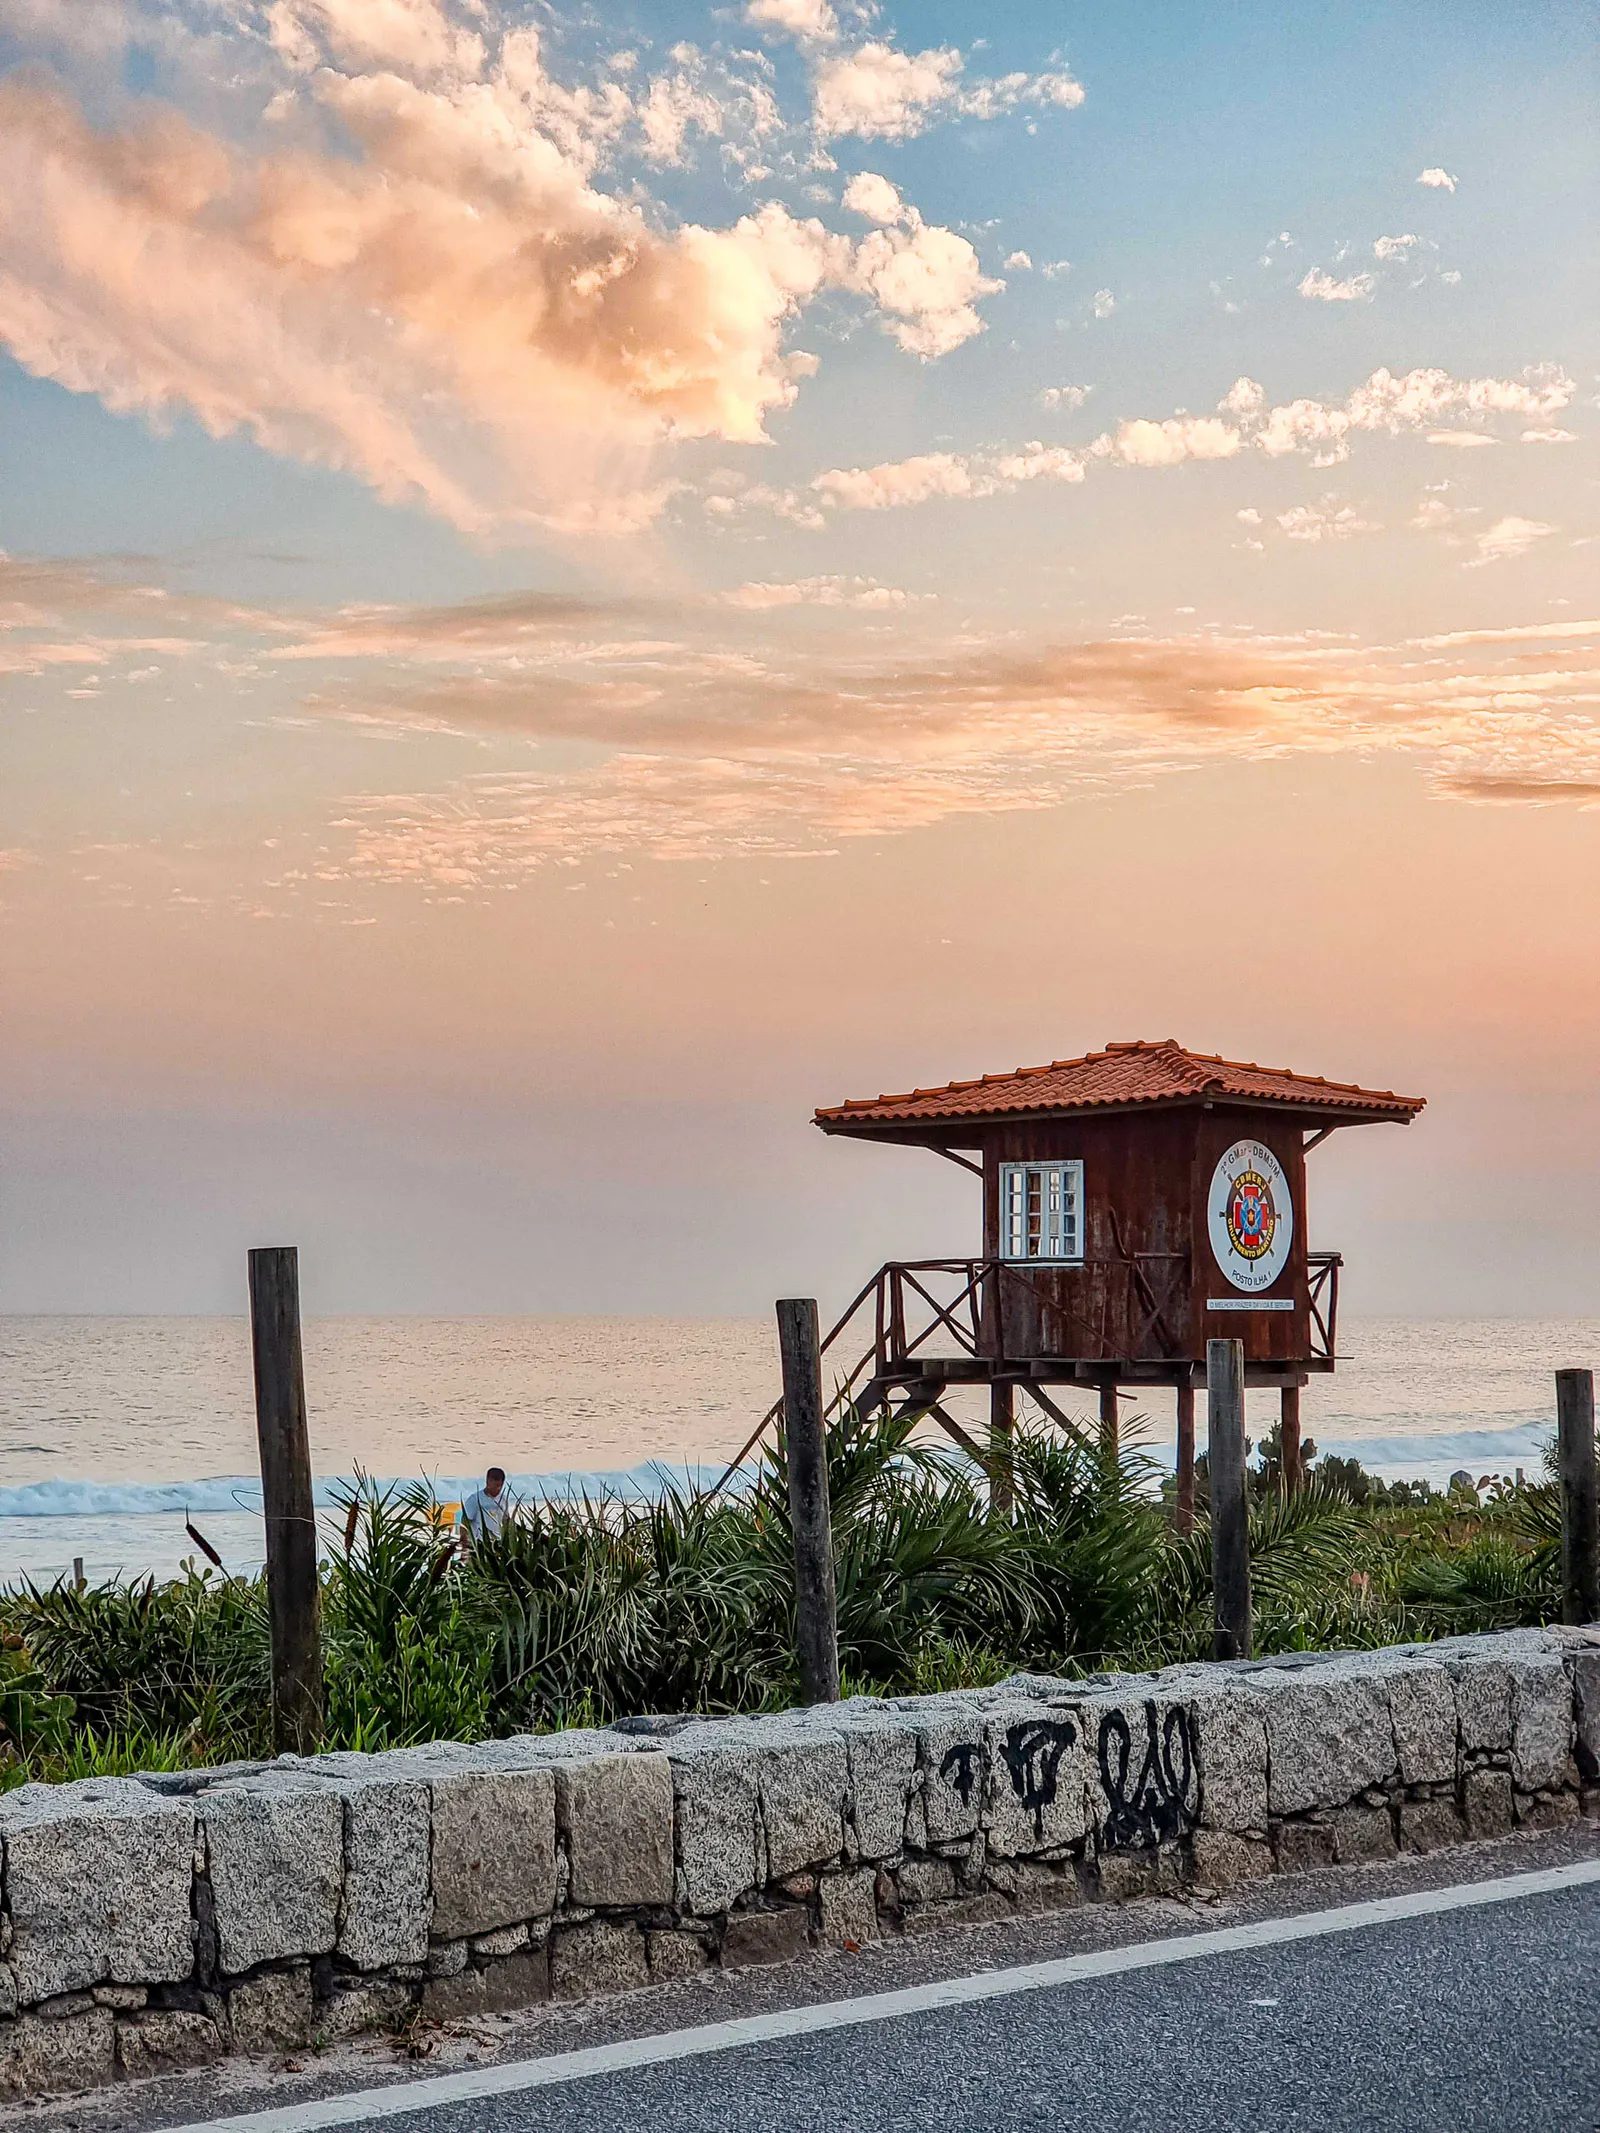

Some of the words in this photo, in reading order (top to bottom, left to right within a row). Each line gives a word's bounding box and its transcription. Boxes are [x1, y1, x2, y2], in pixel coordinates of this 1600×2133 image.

[1227, 1217, 1256, 1258] GRUPAMENTO
[1232, 1269, 1252, 1286] POSTO
[1253, 1274, 1269, 1286] ILHA
